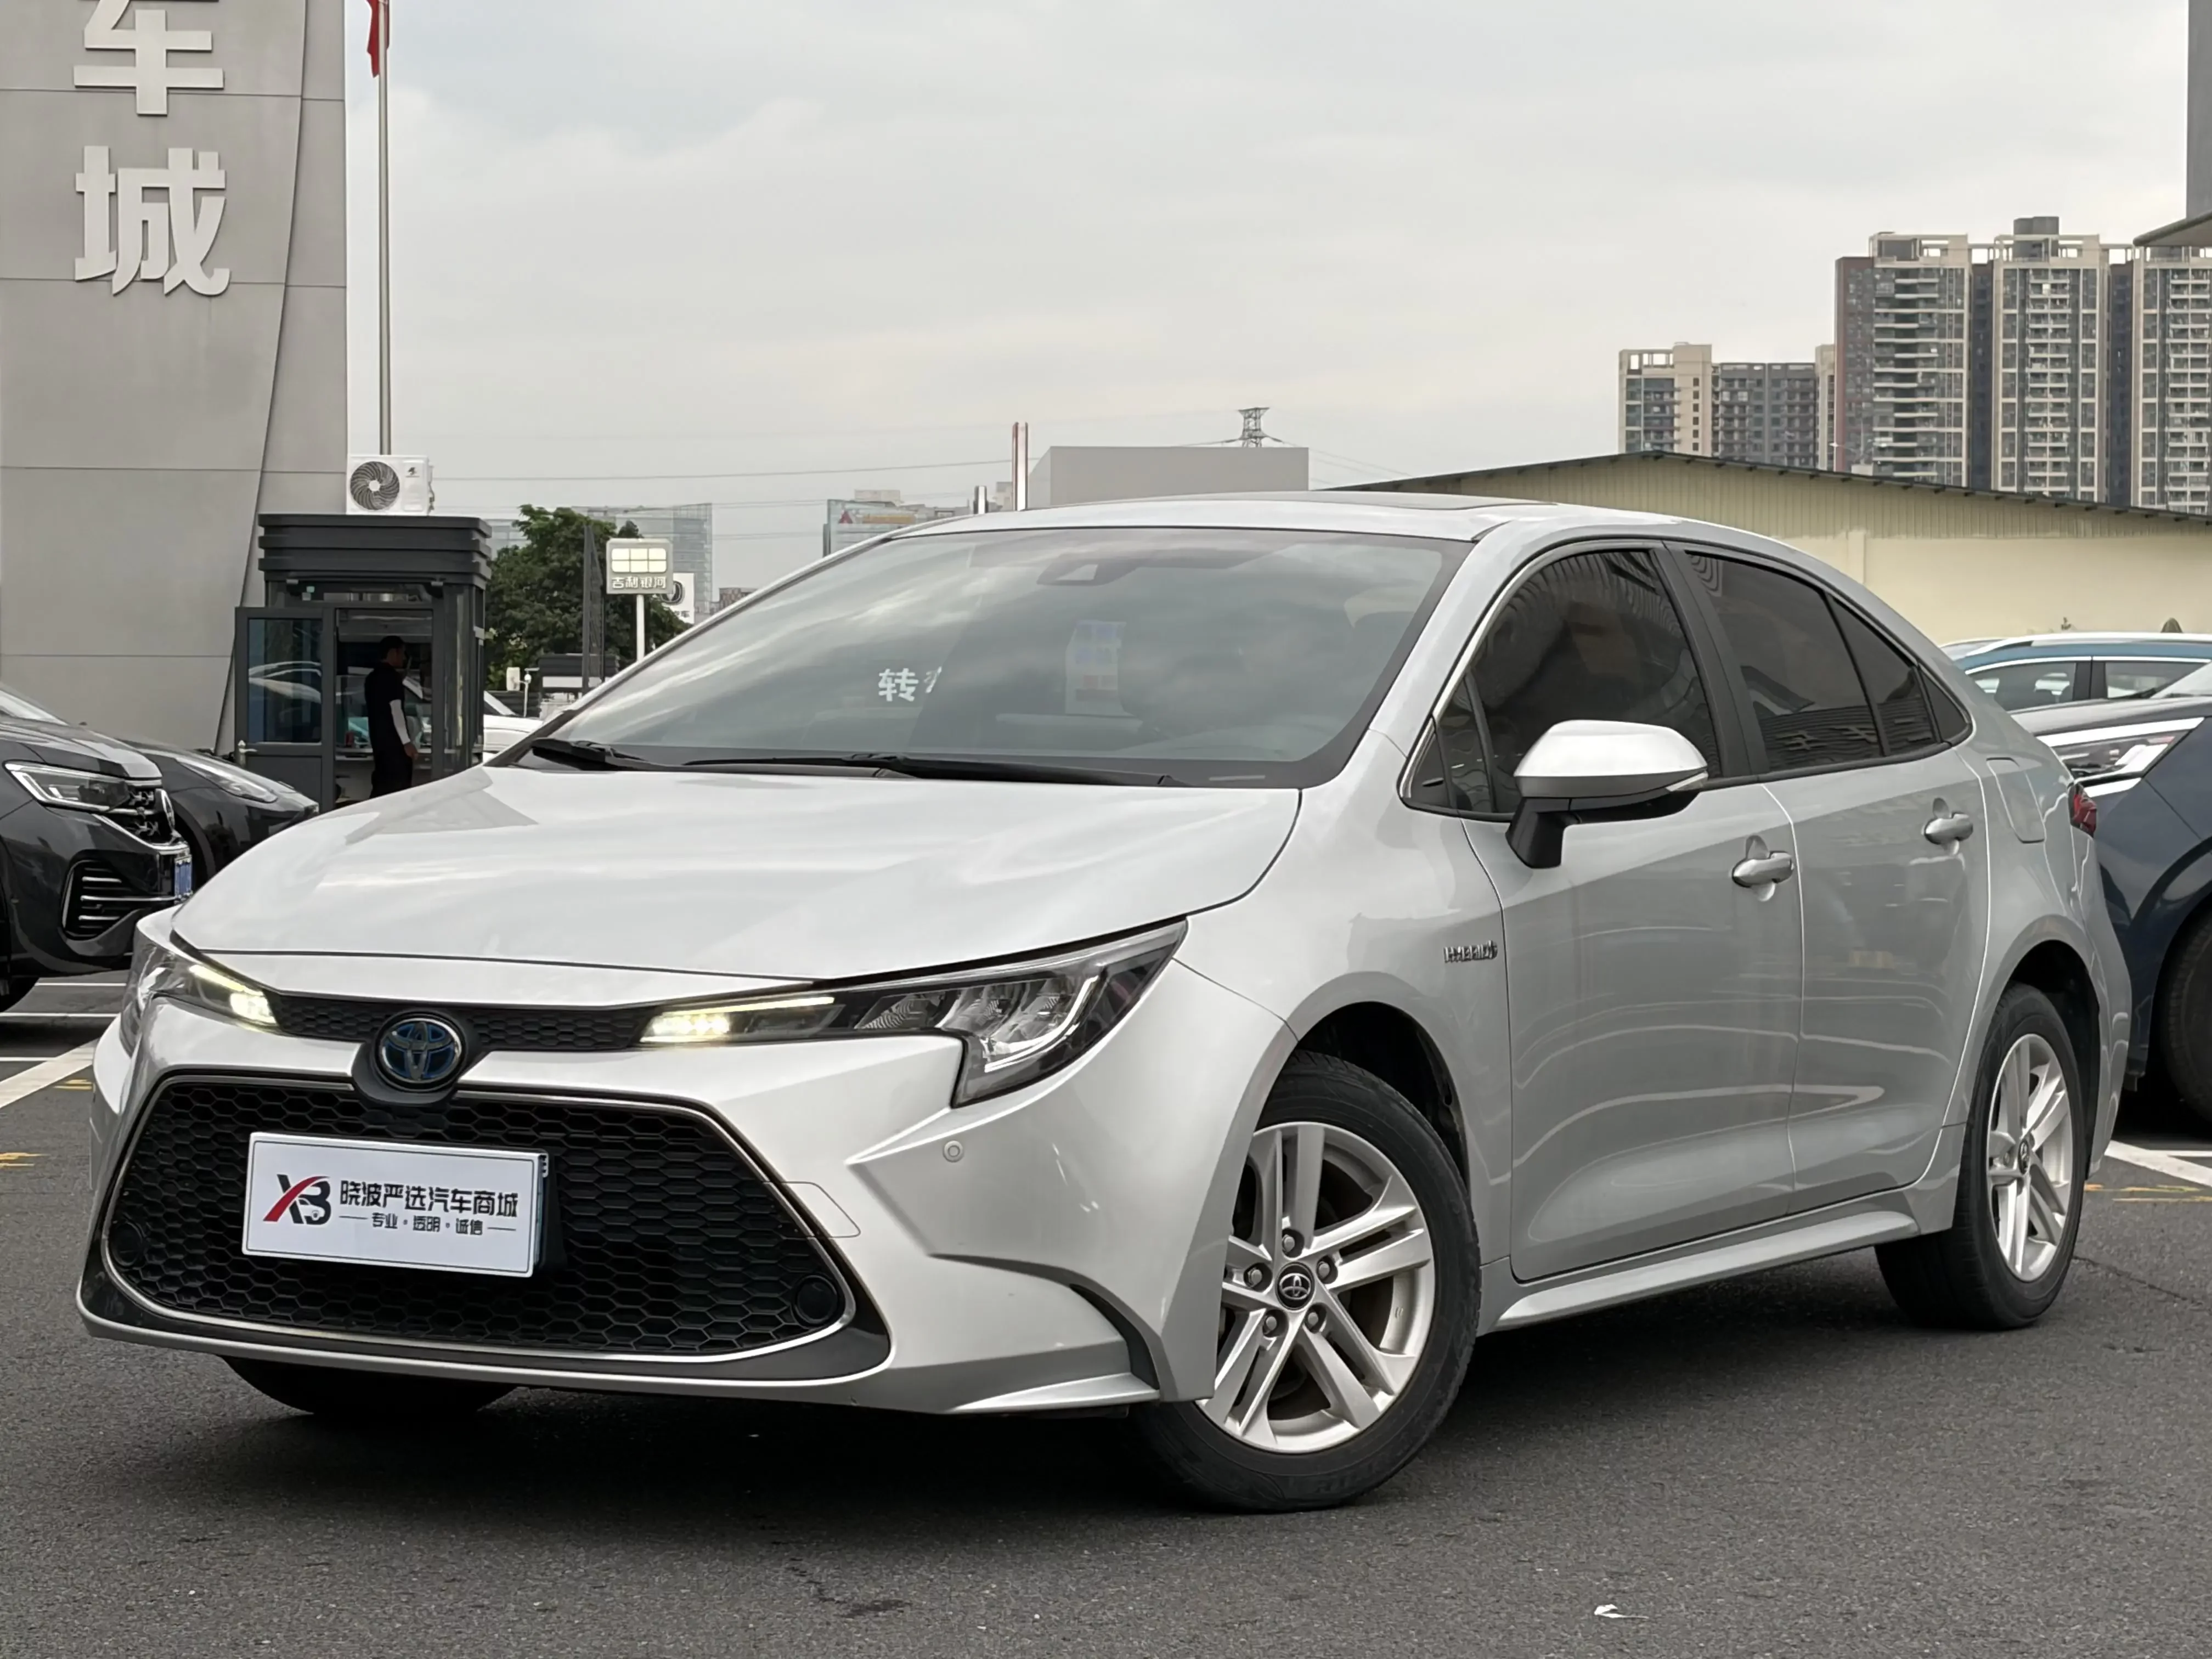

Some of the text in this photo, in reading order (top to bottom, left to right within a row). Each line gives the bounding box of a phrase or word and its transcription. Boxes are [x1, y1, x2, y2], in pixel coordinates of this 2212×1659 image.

[74, 0, 232, 296] 车城
[340, 1180, 518, 1217] 晓波严选汽车商城
